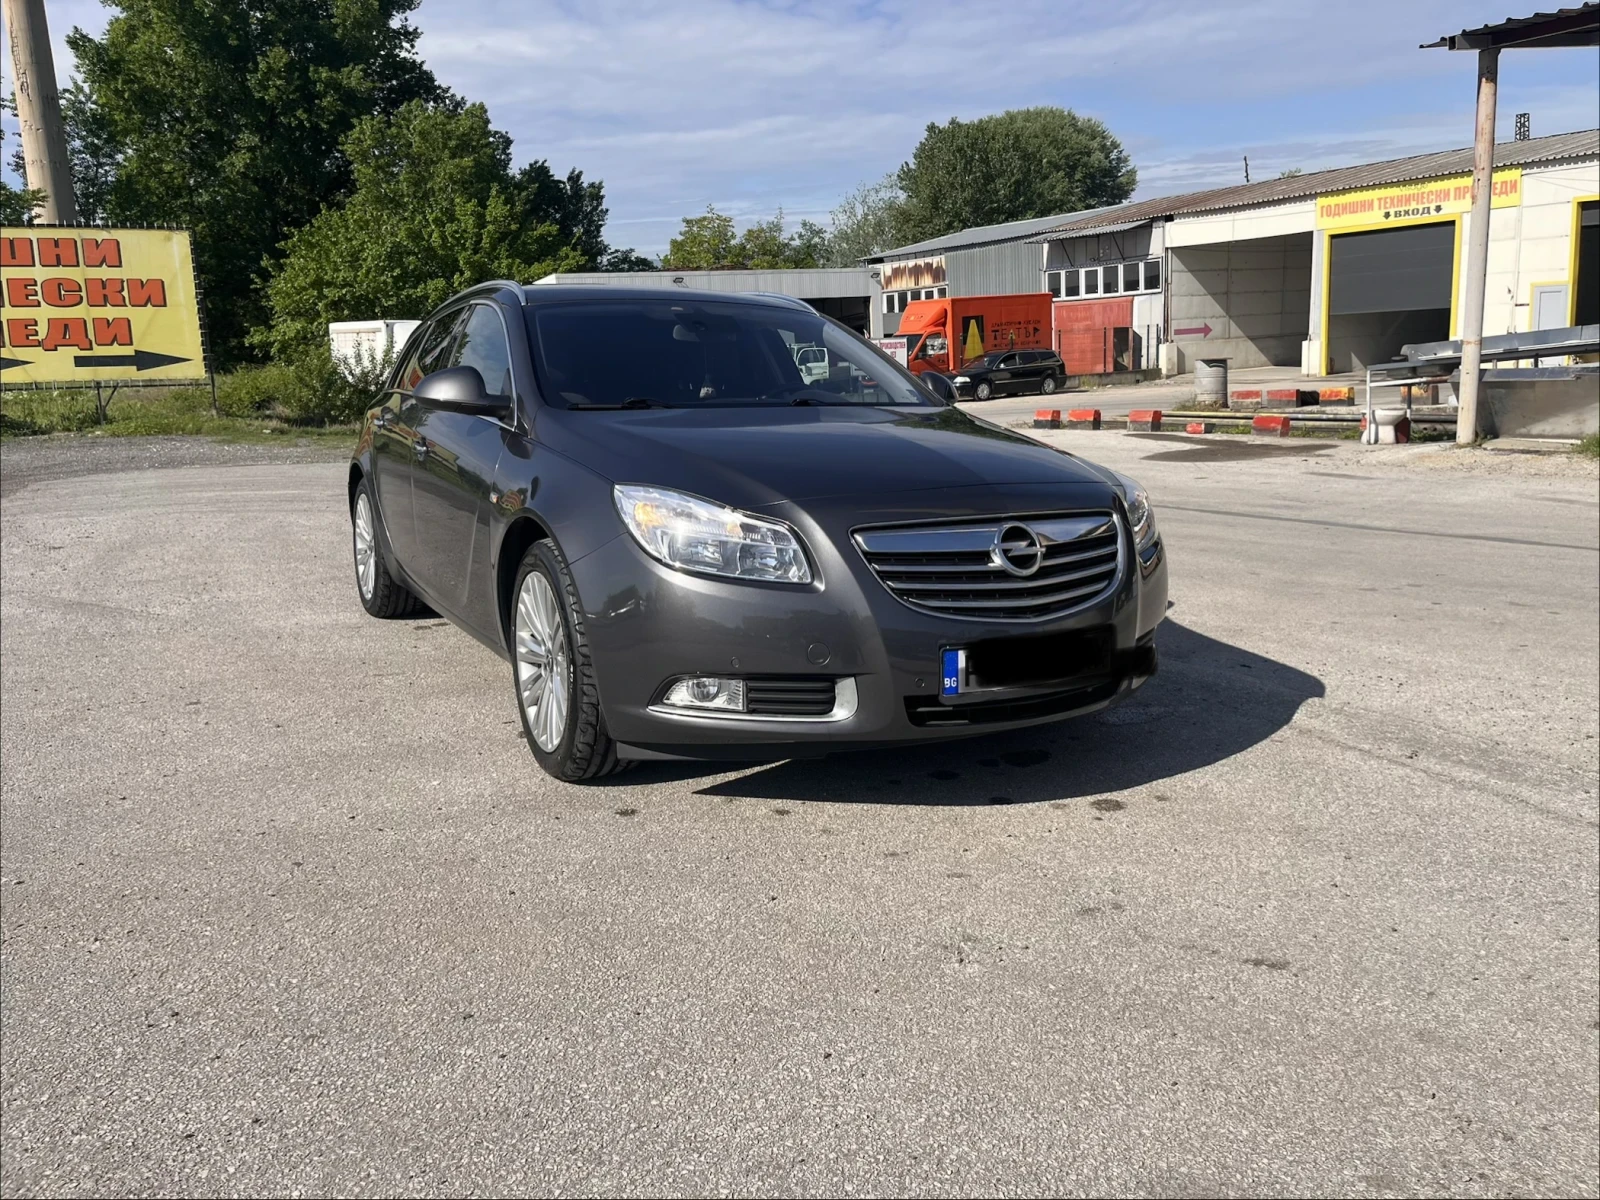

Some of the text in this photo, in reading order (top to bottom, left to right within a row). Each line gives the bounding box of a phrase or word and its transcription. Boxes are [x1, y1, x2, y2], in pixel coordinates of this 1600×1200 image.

[1320, 198, 1375, 219] ГОДИШНИ
[1376, 187, 1451, 211] ТЕХНИЧЕСКИ
[1454, 179, 1518, 201] ПРЕДИ
[1394, 206, 1431, 218] ВХОД
[0, 278, 167, 307] ЕСКИ
[0, 317, 133, 352] ЕДИ
[991, 326, 1041, 341] ТЕАТЪР
[944, 677, 957, 688] BG
